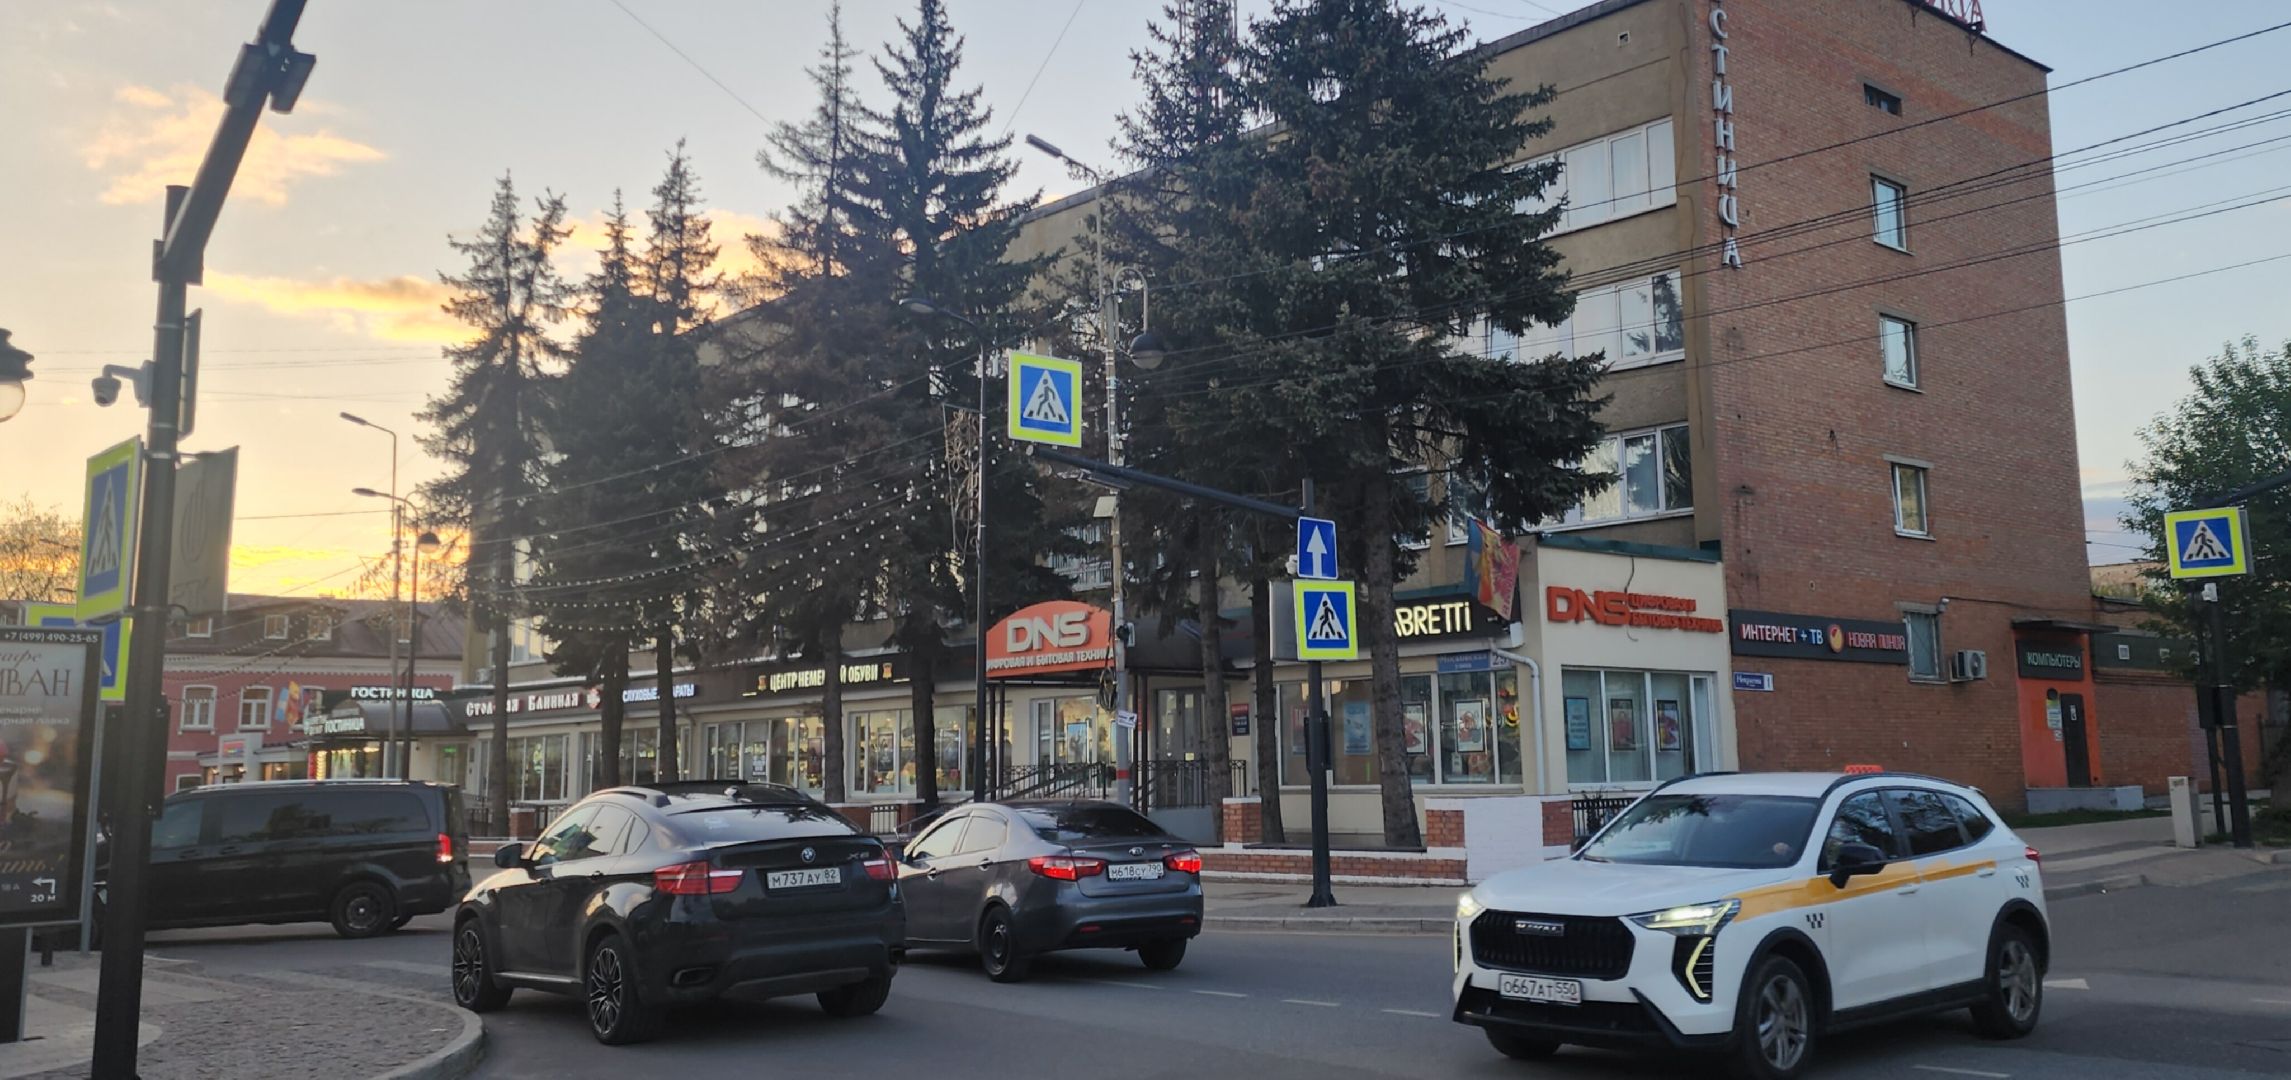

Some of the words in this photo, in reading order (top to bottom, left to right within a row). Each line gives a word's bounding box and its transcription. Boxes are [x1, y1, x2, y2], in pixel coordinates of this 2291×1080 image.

[1709, 9, 1742, 268] СТИНИЦА
[1547, 586, 1631, 627] DNS
[1394, 602, 1471, 637] BRETTi
[19, 632, 45, 642] (499)
[47, 632, 98, 643] 490-25-65
[1007, 610, 1088, 653] DNS
[1741, 623, 1798, 643] ИНТЕРНЕТ
[1800, 631, 1807, 641] +
[1809, 629, 1824, 645] ТВ
[1848, 632, 1877, 648] НОВАЯ
[1037, 652, 1074, 667] БЫТОВАЯ
[2027, 651, 2081, 668] КОМПЬЮТЕРЫ
[770, 672, 797, 692] ЦЕНТР
[798, 665, 846, 688] НЕМЕЙ
[849, 664, 878, 682] ОБУВИ
[622, 687, 657, 703] СЛУХОВЫЕ
[325, 717, 365, 734] ГОСТИНИЦА
[1148, 864, 1162, 872] 790
[772, 871, 821, 888] М737АУ
[824, 869, 836, 880] 82
[31, 894, 44, 903] 20
[1504, 979, 1553, 997] О667АТ
[1556, 982, 1577, 995] 550
